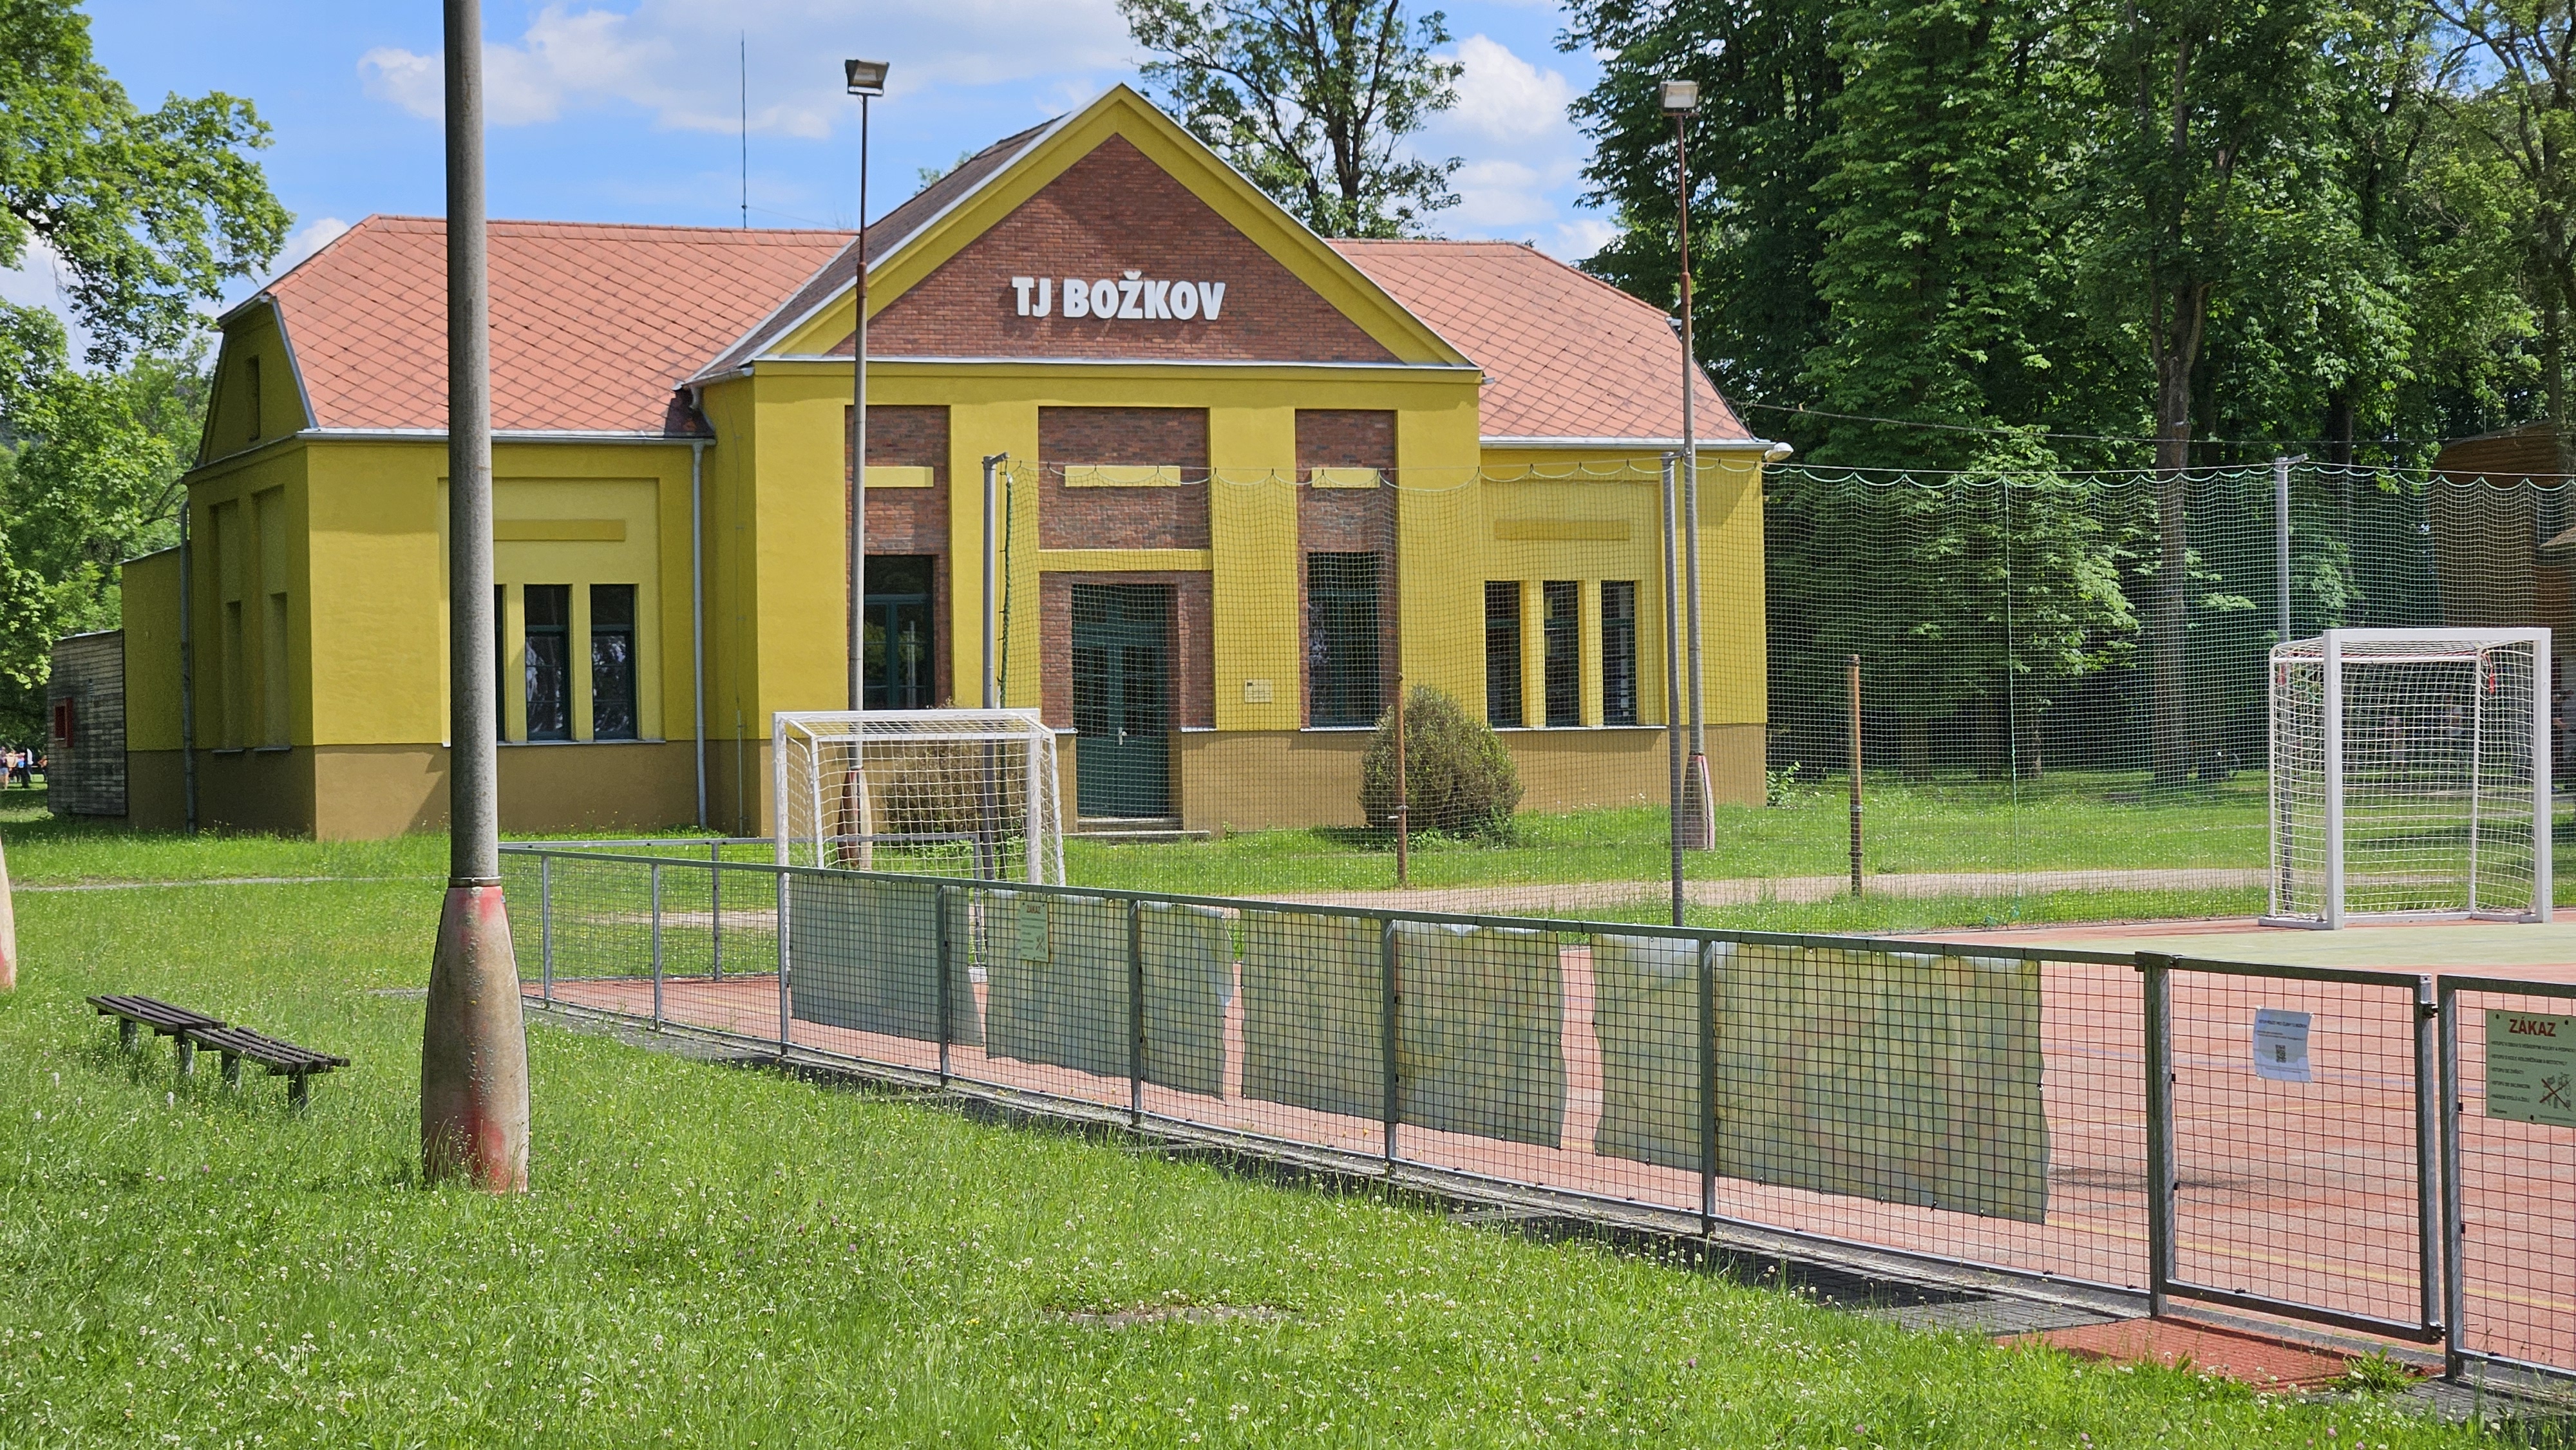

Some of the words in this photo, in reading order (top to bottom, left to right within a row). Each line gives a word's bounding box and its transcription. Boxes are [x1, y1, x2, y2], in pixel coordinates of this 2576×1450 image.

[1012, 276, 1052, 317] TJ
[1063, 270, 1226, 320] BOŽKOV
[2508, 1016, 2557, 1037] ZÁKAZ
